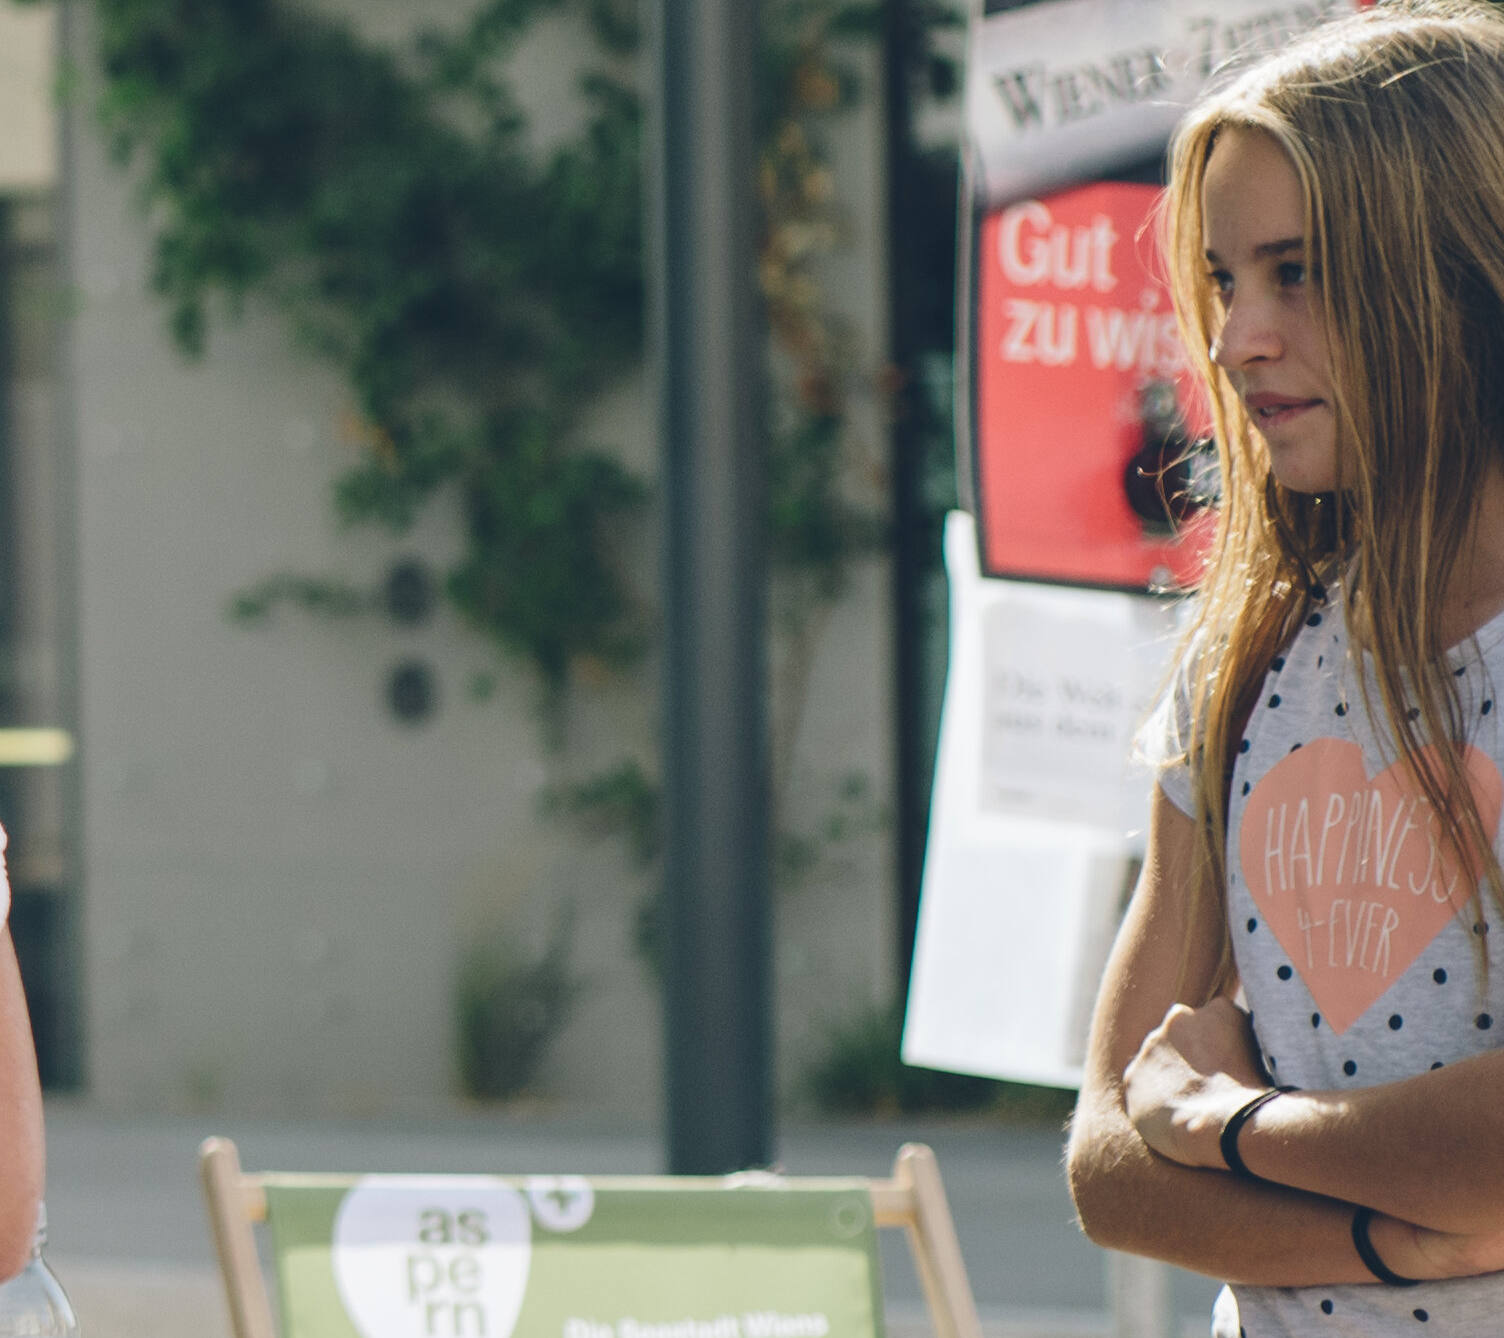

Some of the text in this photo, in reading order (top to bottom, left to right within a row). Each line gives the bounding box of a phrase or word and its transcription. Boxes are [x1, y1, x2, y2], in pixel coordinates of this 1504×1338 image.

[997, 199, 1119, 293] Gut
[1001, 296, 1079, 367] zu
[419, 1205, 490, 1246] as
[407, 1255, 483, 1303] pe
